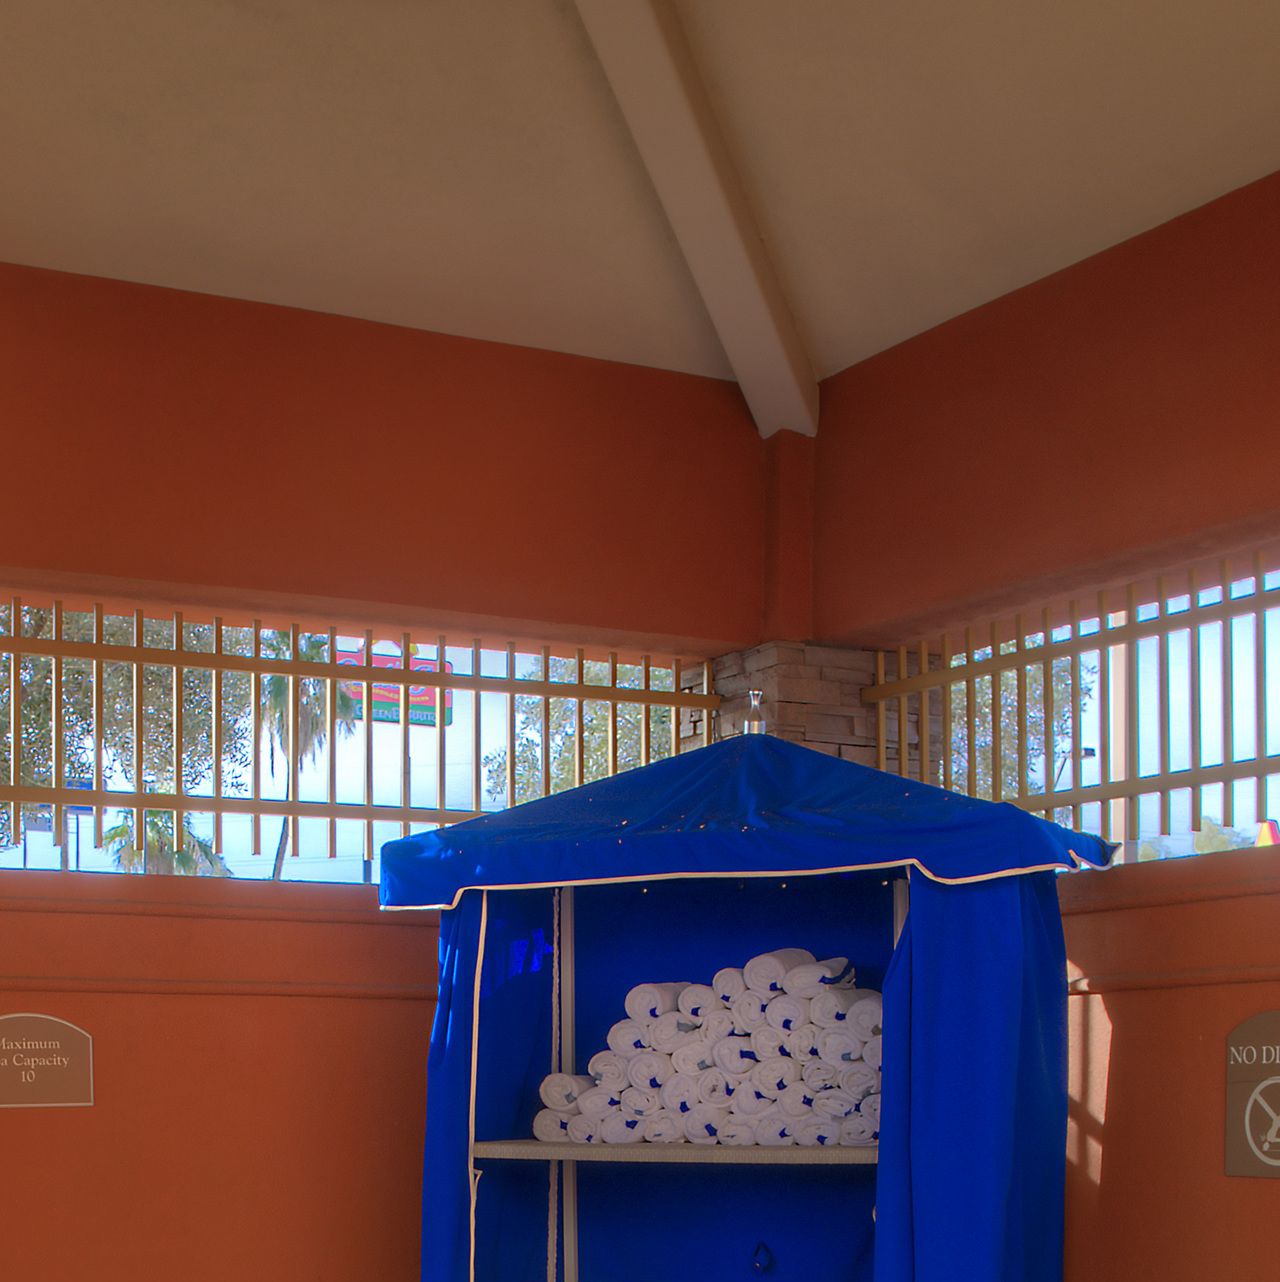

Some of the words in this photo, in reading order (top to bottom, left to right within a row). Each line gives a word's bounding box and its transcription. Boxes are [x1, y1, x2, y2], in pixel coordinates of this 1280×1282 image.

[355, 703, 391, 719] GEEN
[12, 1053, 70, 1068] Capacity
[1229, 1045, 1257, 1065] NO
[21, 1070, 36, 1082] 10
